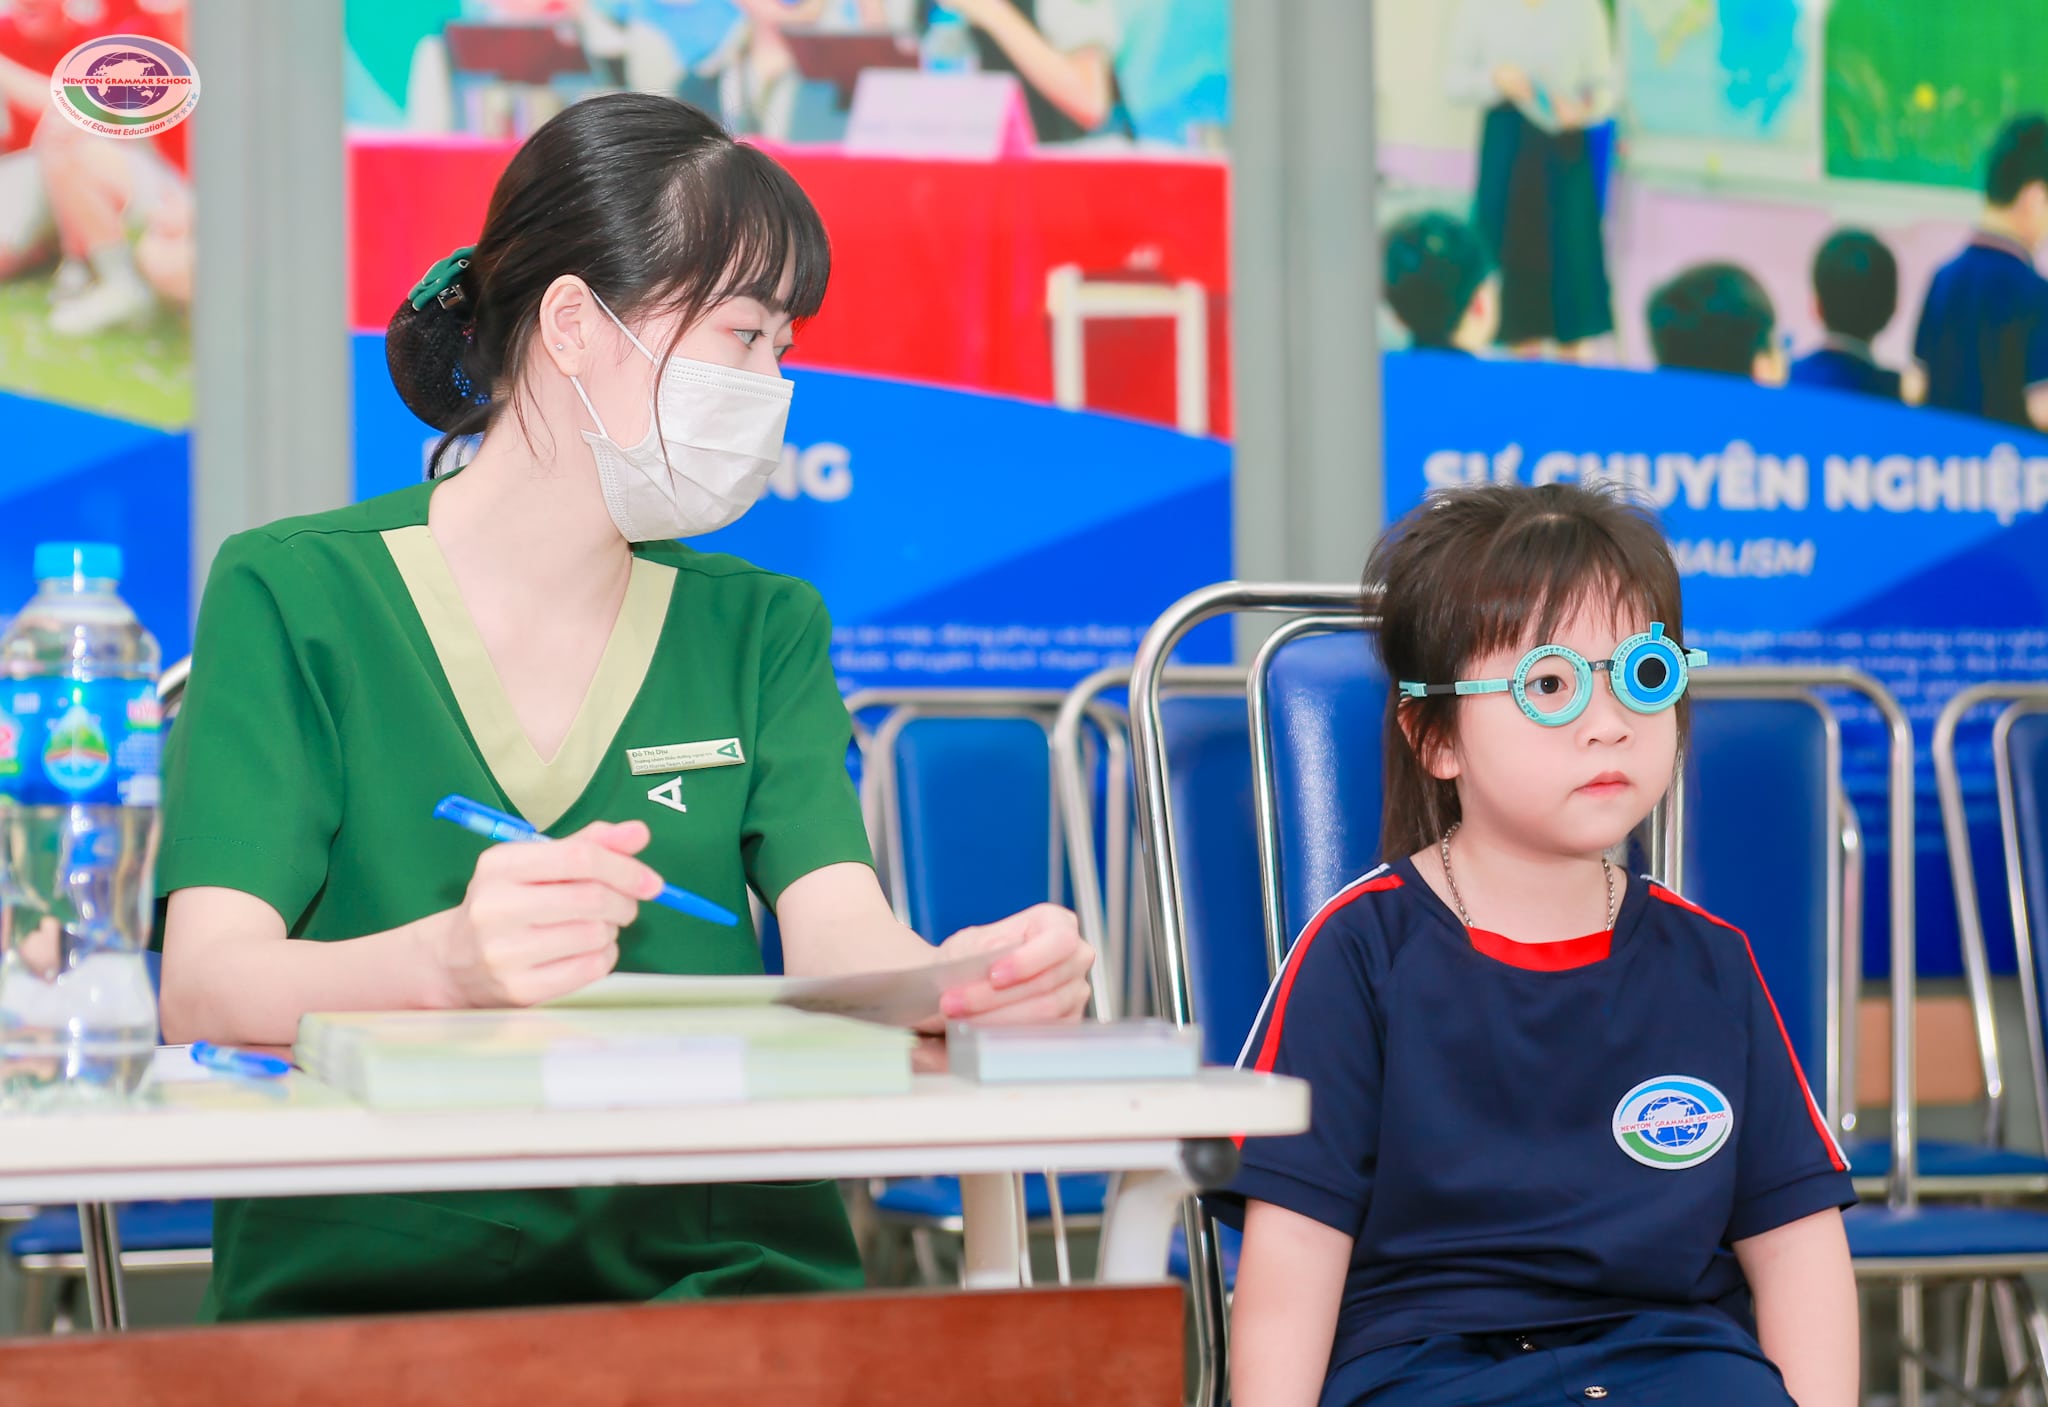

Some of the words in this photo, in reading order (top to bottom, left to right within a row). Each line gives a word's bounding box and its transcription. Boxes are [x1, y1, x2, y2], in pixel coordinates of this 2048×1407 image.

[1620, 1122, 1651, 1132] NEWTON
[1655, 1117, 1694, 1128] GRAMMAR
[1697, 1112, 1726, 1123] SCHOOL
